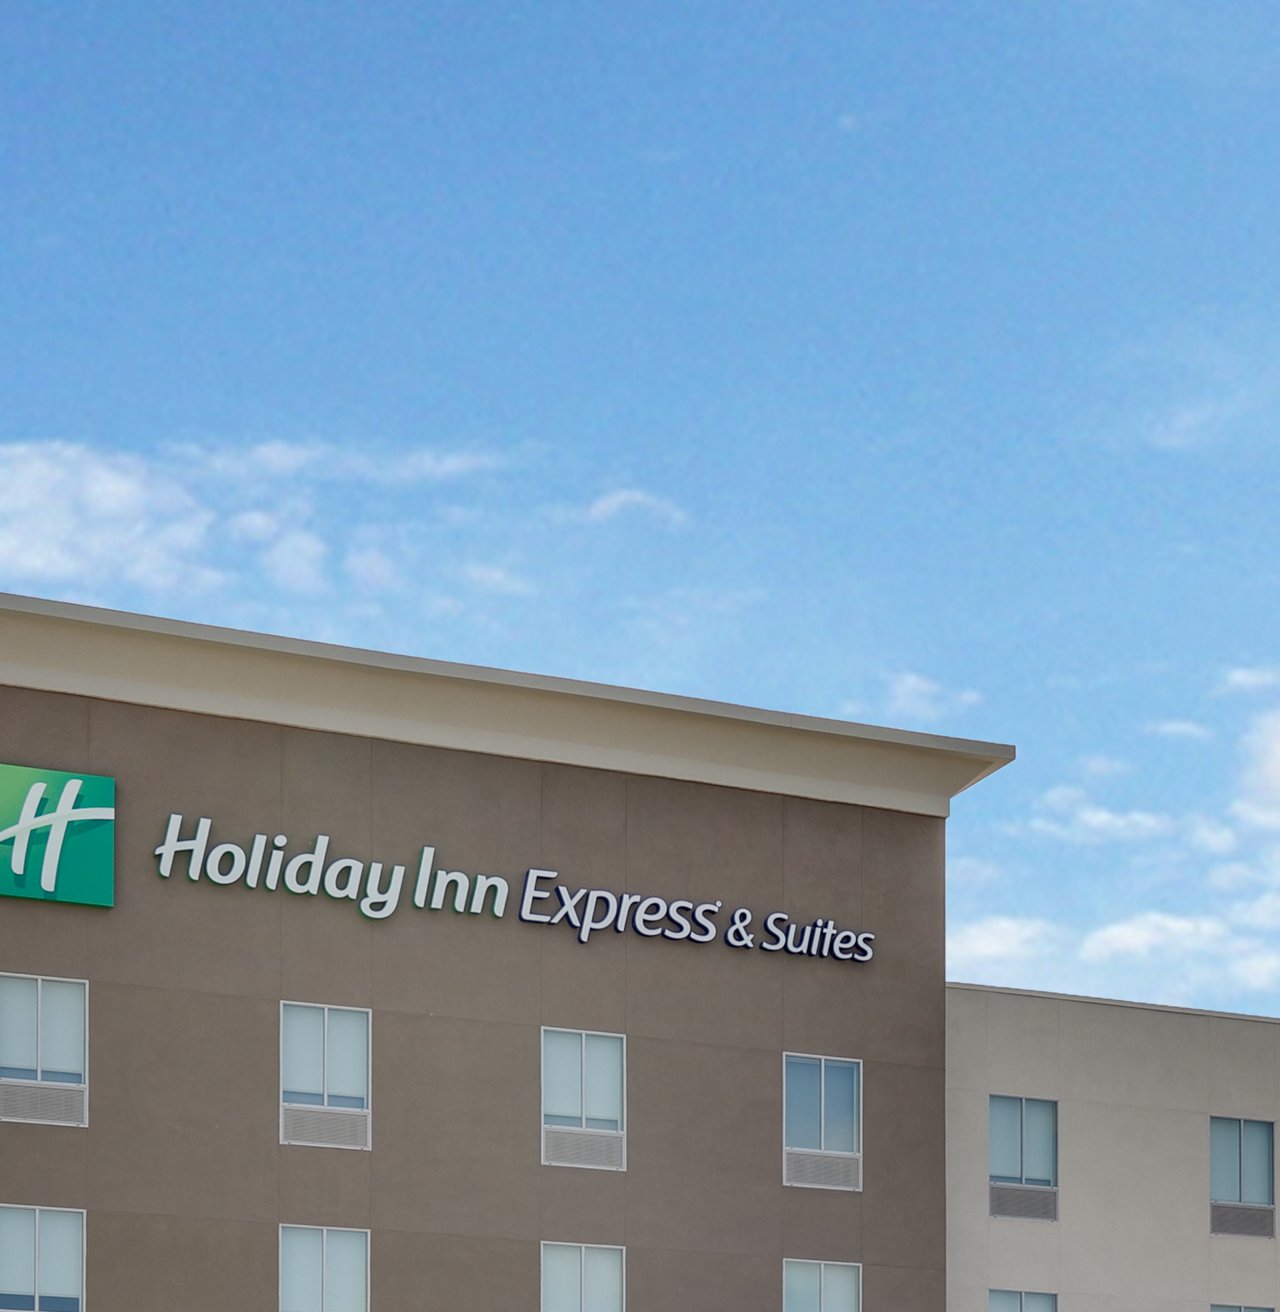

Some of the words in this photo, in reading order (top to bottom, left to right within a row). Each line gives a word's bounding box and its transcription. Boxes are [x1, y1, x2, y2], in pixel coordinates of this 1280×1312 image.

[155, 813, 406, 919] Holiday
[413, 846, 510, 918] Inn
[520, 868, 722, 943] Express
[725, 907, 755, 949] &
[761, 912, 876, 963] Suites
